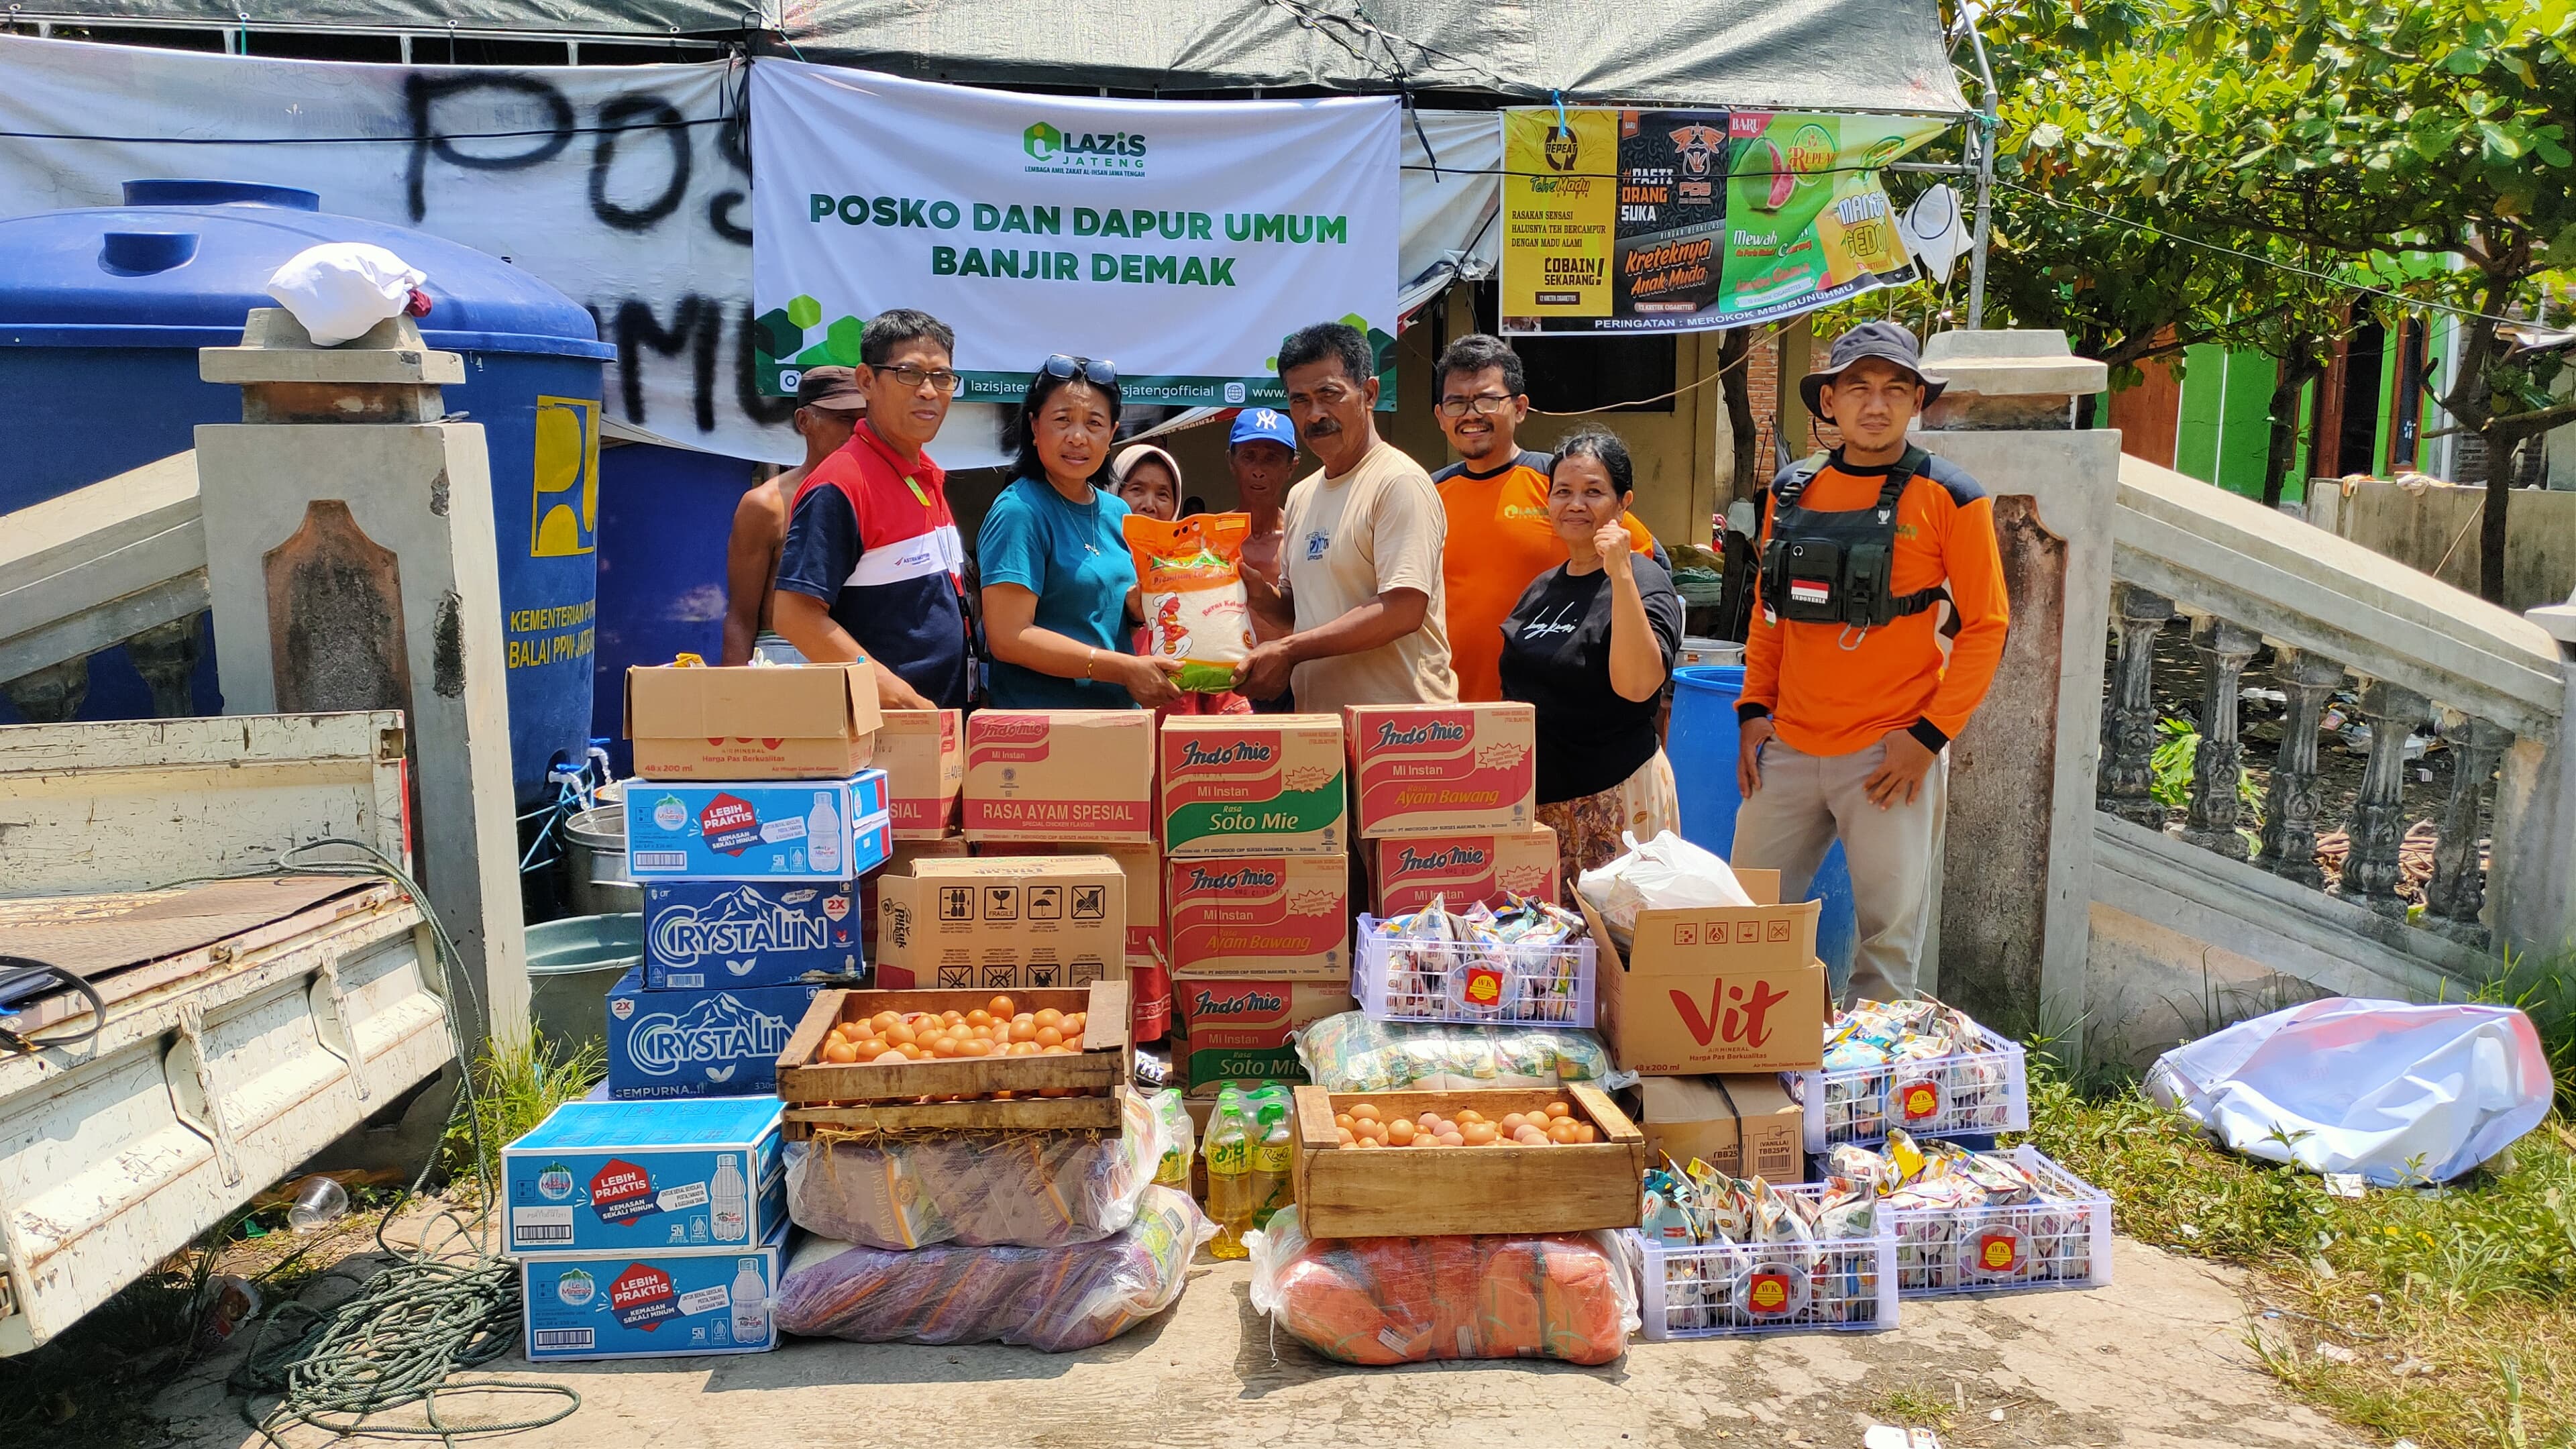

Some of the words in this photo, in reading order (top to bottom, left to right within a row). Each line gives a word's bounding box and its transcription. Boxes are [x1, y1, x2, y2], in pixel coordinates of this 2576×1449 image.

[1731, 118, 1761, 133] BARU
[1545, 142, 1578, 154] REPEAT
[1063, 156, 1144, 168] JATENG
[1622, 168, 1674, 184] #PASTI
[1555, 176, 1591, 196] Madu
[1622, 186, 1668, 203] ORANG
[810, 193, 961, 229] POSKO
[973, 202, 1061, 235] DAN
[1073, 207, 1213, 241] DAPUR
[1225, 212, 1347, 245] UMUM
[1512, 209, 1544, 220] RASAKAN
[1545, 209, 1573, 220] SENSASI
[1621, 205, 1656, 221] SUKA
[1511, 224, 1546, 234] HALUSNYA
[1548, 224, 1562, 233] TEH
[1563, 224, 1606, 234] BERCAMPUR
[1511, 239, 1539, 248] DENGAN
[1540, 239, 1560, 248] MADU
[1562, 238, 1582, 247] ALAMI
[1733, 229, 1778, 246] Mewah
[1624, 237, 1711, 274] Kreteknya
[932, 245, 1077, 281] BANJIR
[1091, 252, 1236, 288] DEMAK
[1544, 256, 1595, 272] COBAIN
[1630, 275, 1666, 296] Anak
[1668, 265, 1706, 288] Muda
[1595, 319, 1676, 329] PERINGATAN
[1687, 311, 1755, 327] MEROKOK
[1757, 284, 1854, 315] MEMBUNUHMU
[1792, 594, 1826, 604] INDONESIA
[511, 604, 584, 632] KEMENTERIAN
[509, 637, 550, 669] BALAI
[553, 634, 574, 663] PPW
[973, 717, 1046, 742] Indomie
[1366, 719, 1464, 753] Indomie
[702, 755, 725, 763] Harga
[742, 755, 785, 763] Berkualitas
[991, 751, 1001, 759] Mi
[1002, 751, 1026, 759] Instan
[1171, 740, 1271, 773] Indomie
[1393, 765, 1407, 775] Mi
[1409, 765, 1443, 775] Instan
[1197, 786, 1211, 796] Mi
[1214, 786, 1249, 796] Instan
[1395, 790, 1436, 808] Ayam
[1440, 789, 1500, 806] Bawang
[709, 804, 743, 818] LEBIH
[983, 804, 1022, 819] RASA
[1027, 804, 1069, 820] AYAM
[1073, 805, 1134, 820] SPESIAL
[1223, 805, 1242, 813] Rasa
[704, 812, 753, 829] PRAKTIS
[1209, 813, 1255, 830] Soto
[1260, 812, 1299, 830] Mie
[712, 839, 735, 849] SEKALI
[718, 831, 750, 842] KEMASAN
[1388, 845, 1484, 879] Indomie
[1178, 865, 1275, 897] Indomie
[1414, 890, 1428, 901] Mi
[828, 899, 846, 910] 2X
[1204, 910, 1218, 920] Mi
[1218, 910, 1254, 920] Instan
[649, 904, 828, 969] CRYSTALIN
[1205, 934, 1248, 955] Ayam
[1250, 935, 1311, 952] Bawang
[1477, 979, 1492, 987] WK
[616, 1002, 631, 1010] 2X
[1191, 988, 1282, 1018] Indomie
[1668, 977, 1790, 1049] Vit
[1209, 1033, 1222, 1043] Mi
[1223, 1033, 1259, 1044] Instan
[1219, 1058, 1265, 1075] Soto
[1269, 1058, 1305, 1075] Mie
[1913, 1091, 1929, 1102] WK
[1759, 1147, 1790, 1155] TBB25PV
[1760, 1140, 1789, 1148] (VANILLA)
[1261, 1147, 1289, 1163] Rizki
[601, 1171, 637, 1188] LEBIH
[595, 1180, 647, 1199] PRAKTIS
[602, 1209, 630, 1220] SEKALI
[630, 1203, 655, 1215] MINUM
[608, 1199, 645, 1212] KEMASAN
[1990, 1246, 2008, 1255] WK
[620, 1275, 658, 1293] LEBIH
[1760, 1284, 1779, 1294] WK
[614, 1283, 669, 1303] PRAKTIS
[623, 1312, 650, 1325] SEKALI
[650, 1307, 675, 1320] MINUM
[629, 1303, 665, 1317] KEMASAN
